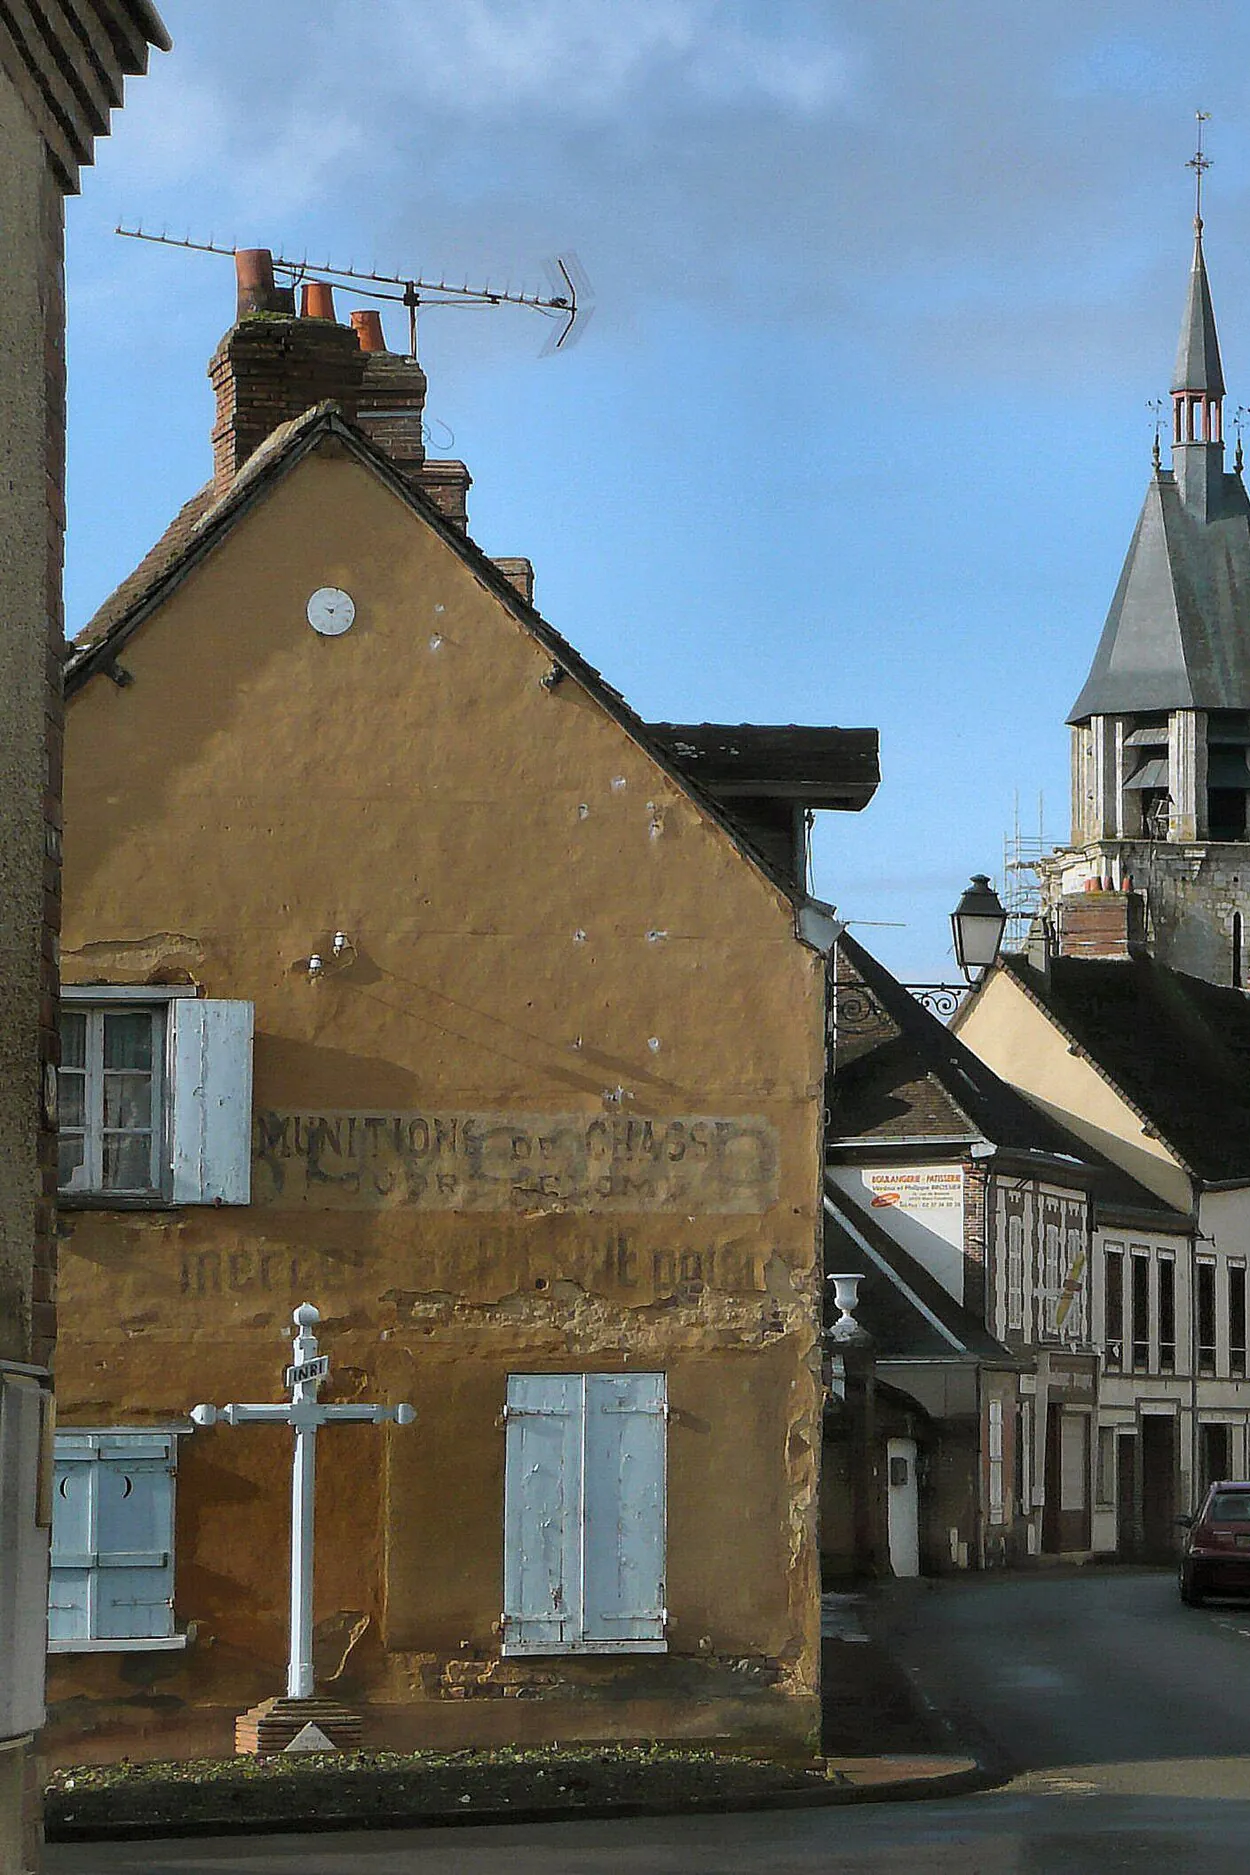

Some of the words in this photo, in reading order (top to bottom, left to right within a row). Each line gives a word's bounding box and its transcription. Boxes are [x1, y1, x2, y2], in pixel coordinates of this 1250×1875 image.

[256, 1113, 484, 1158] MUNITIONS
[871, 1174, 920, 1184] BOULANGERIE
[293, 1360, 323, 1382] INRI
